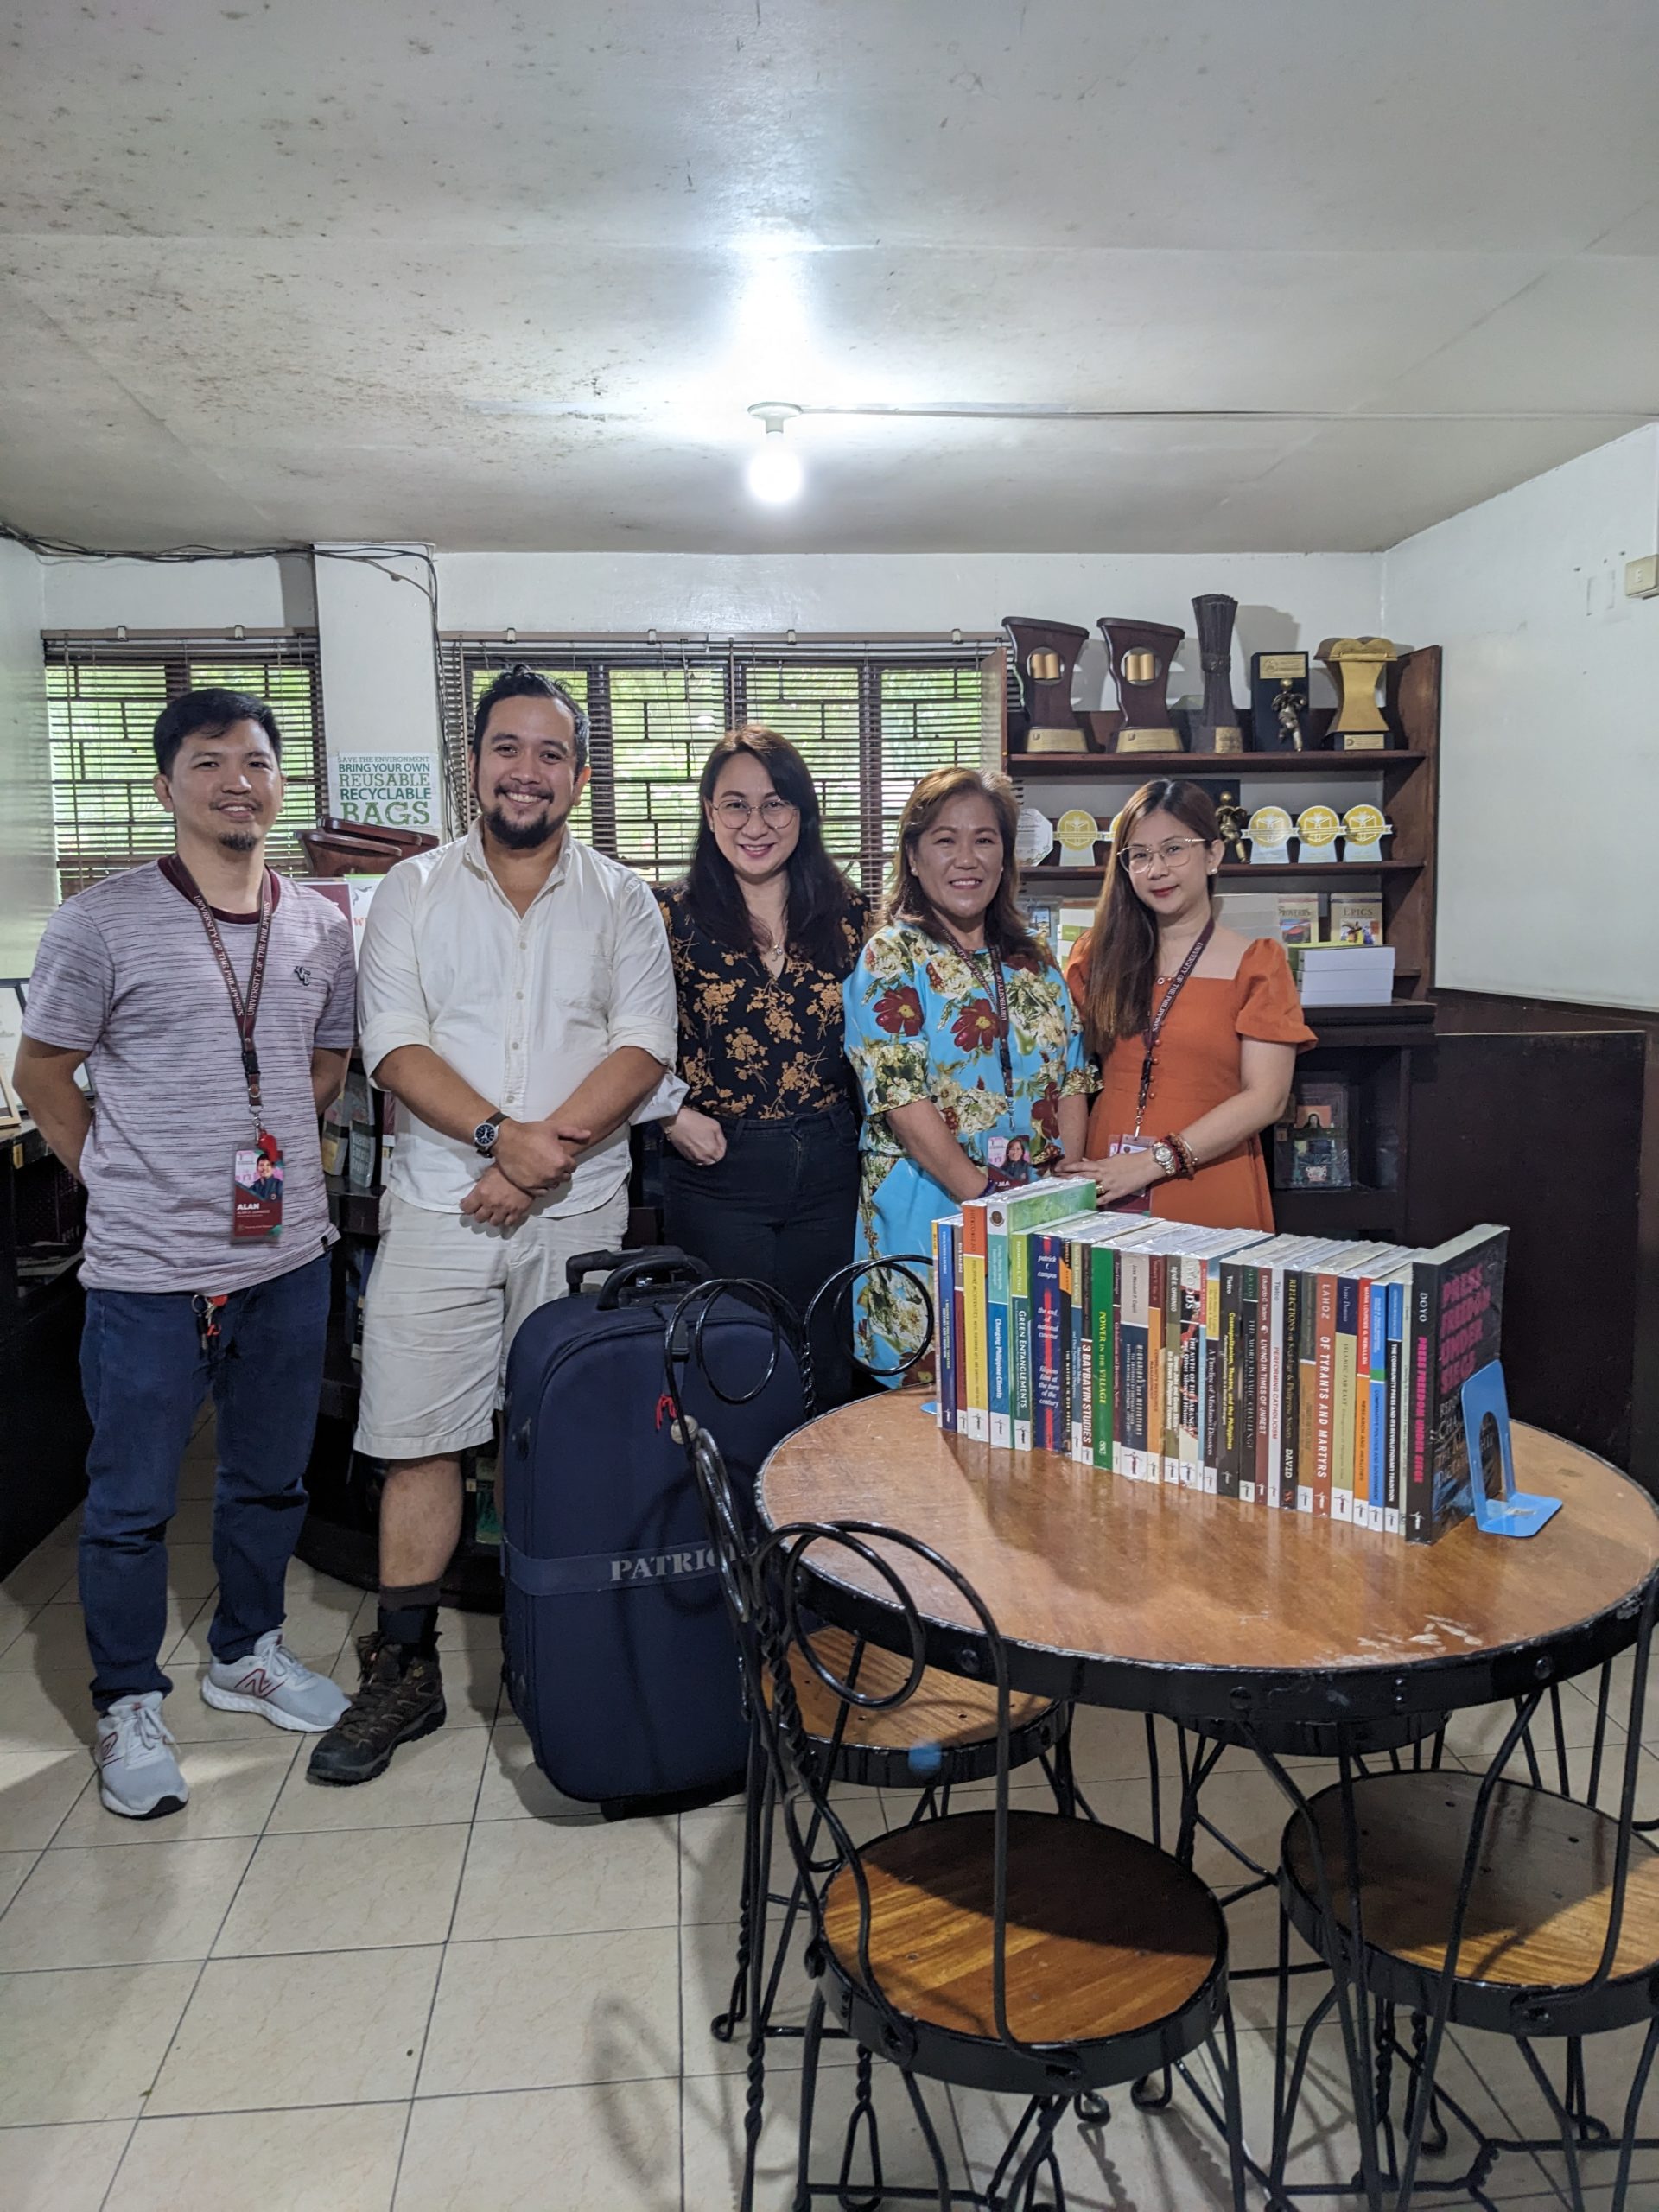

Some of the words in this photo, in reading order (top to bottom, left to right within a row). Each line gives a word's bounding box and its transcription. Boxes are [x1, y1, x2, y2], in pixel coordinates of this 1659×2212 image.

[339, 763, 371, 772] BRING
[372, 763, 402, 772] YOUR
[404, 763, 430, 772] OWN
[339, 773, 430, 787] REUSABLE
[340, 788, 432, 800] RECYCLABLE
[340, 801, 430, 825] BAGS
[1344, 907, 1373, 917] EPICS
[194, 895, 218, 938] UNIVERSITY
[213, 939, 223, 951] OF
[219, 951, 230, 969] THE
[256, 961, 264, 971] OF
[257, 944, 267, 961] THE
[247, 972, 262, 1015] UNIVERSITY
[1167, 983, 1179, 996] THE
[1176, 975, 1185, 983] OF
[997, 982, 1007, 1020] UNIVERSITY
[1037, 1271, 1058, 1280] campos
[1185, 1262, 1195, 1309] WOODS
[1440, 1262, 1484, 1309] PRESS
[1287, 1279, 1297, 1332] REFLECTIONS
[1321, 1284, 1331, 1319] LAHOZ
[1419, 1292, 1428, 1323] DOYO
[1440, 1286, 1491, 1339] FREEDOM
[1098, 1312, 1107, 1342] POWER
[1227, 1313, 1236, 1365] Cosmopolitanism,
[1440, 1318, 1484, 1367] UNDER
[1320, 1336, 1331, 1350] OF
[1417, 1336, 1427, 1369] PRESS
[995, 1346, 1003, 1376] Philippine
[1207, 1356, 1216, 1383] Timeline
[1319, 1354, 1330, 1399] TYRANTS
[1440, 1350, 1477, 1395] SIEGE
[1082, 1353, 1091, 1403] BAYBAYIN
[1098, 1369, 1107, 1404] VILLAGE
[1189, 1373, 1196, 1382] OF
[1208, 1384, 1216, 1393] of
[1247, 1366, 1255, 1397] ISLAMIC
[1039, 1399, 1059, 1408] century
[1260, 1397, 1267, 1406] OF
[1285, 1382, 1294, 1414] Philippine
[1415, 1370, 1427, 1417] FREEDOM
[1082, 1404, 1092, 1443] STUDIES
[1207, 1394, 1216, 1427] Mindanao
[1246, 1402, 1255, 1448] CHALLENGE
[1319, 1403, 1329, 1425] AND
[1206, 1427, 1215, 1455] Disasters
[1226, 1417, 1235, 1450] Philippines
[1414, 1419, 1426, 1453] UNDER
[1284, 1448, 1294, 1478] DAVID
[1317, 1429, 1328, 1478] MARTYRS
[1414, 1454, 1424, 1483] SIEGE
